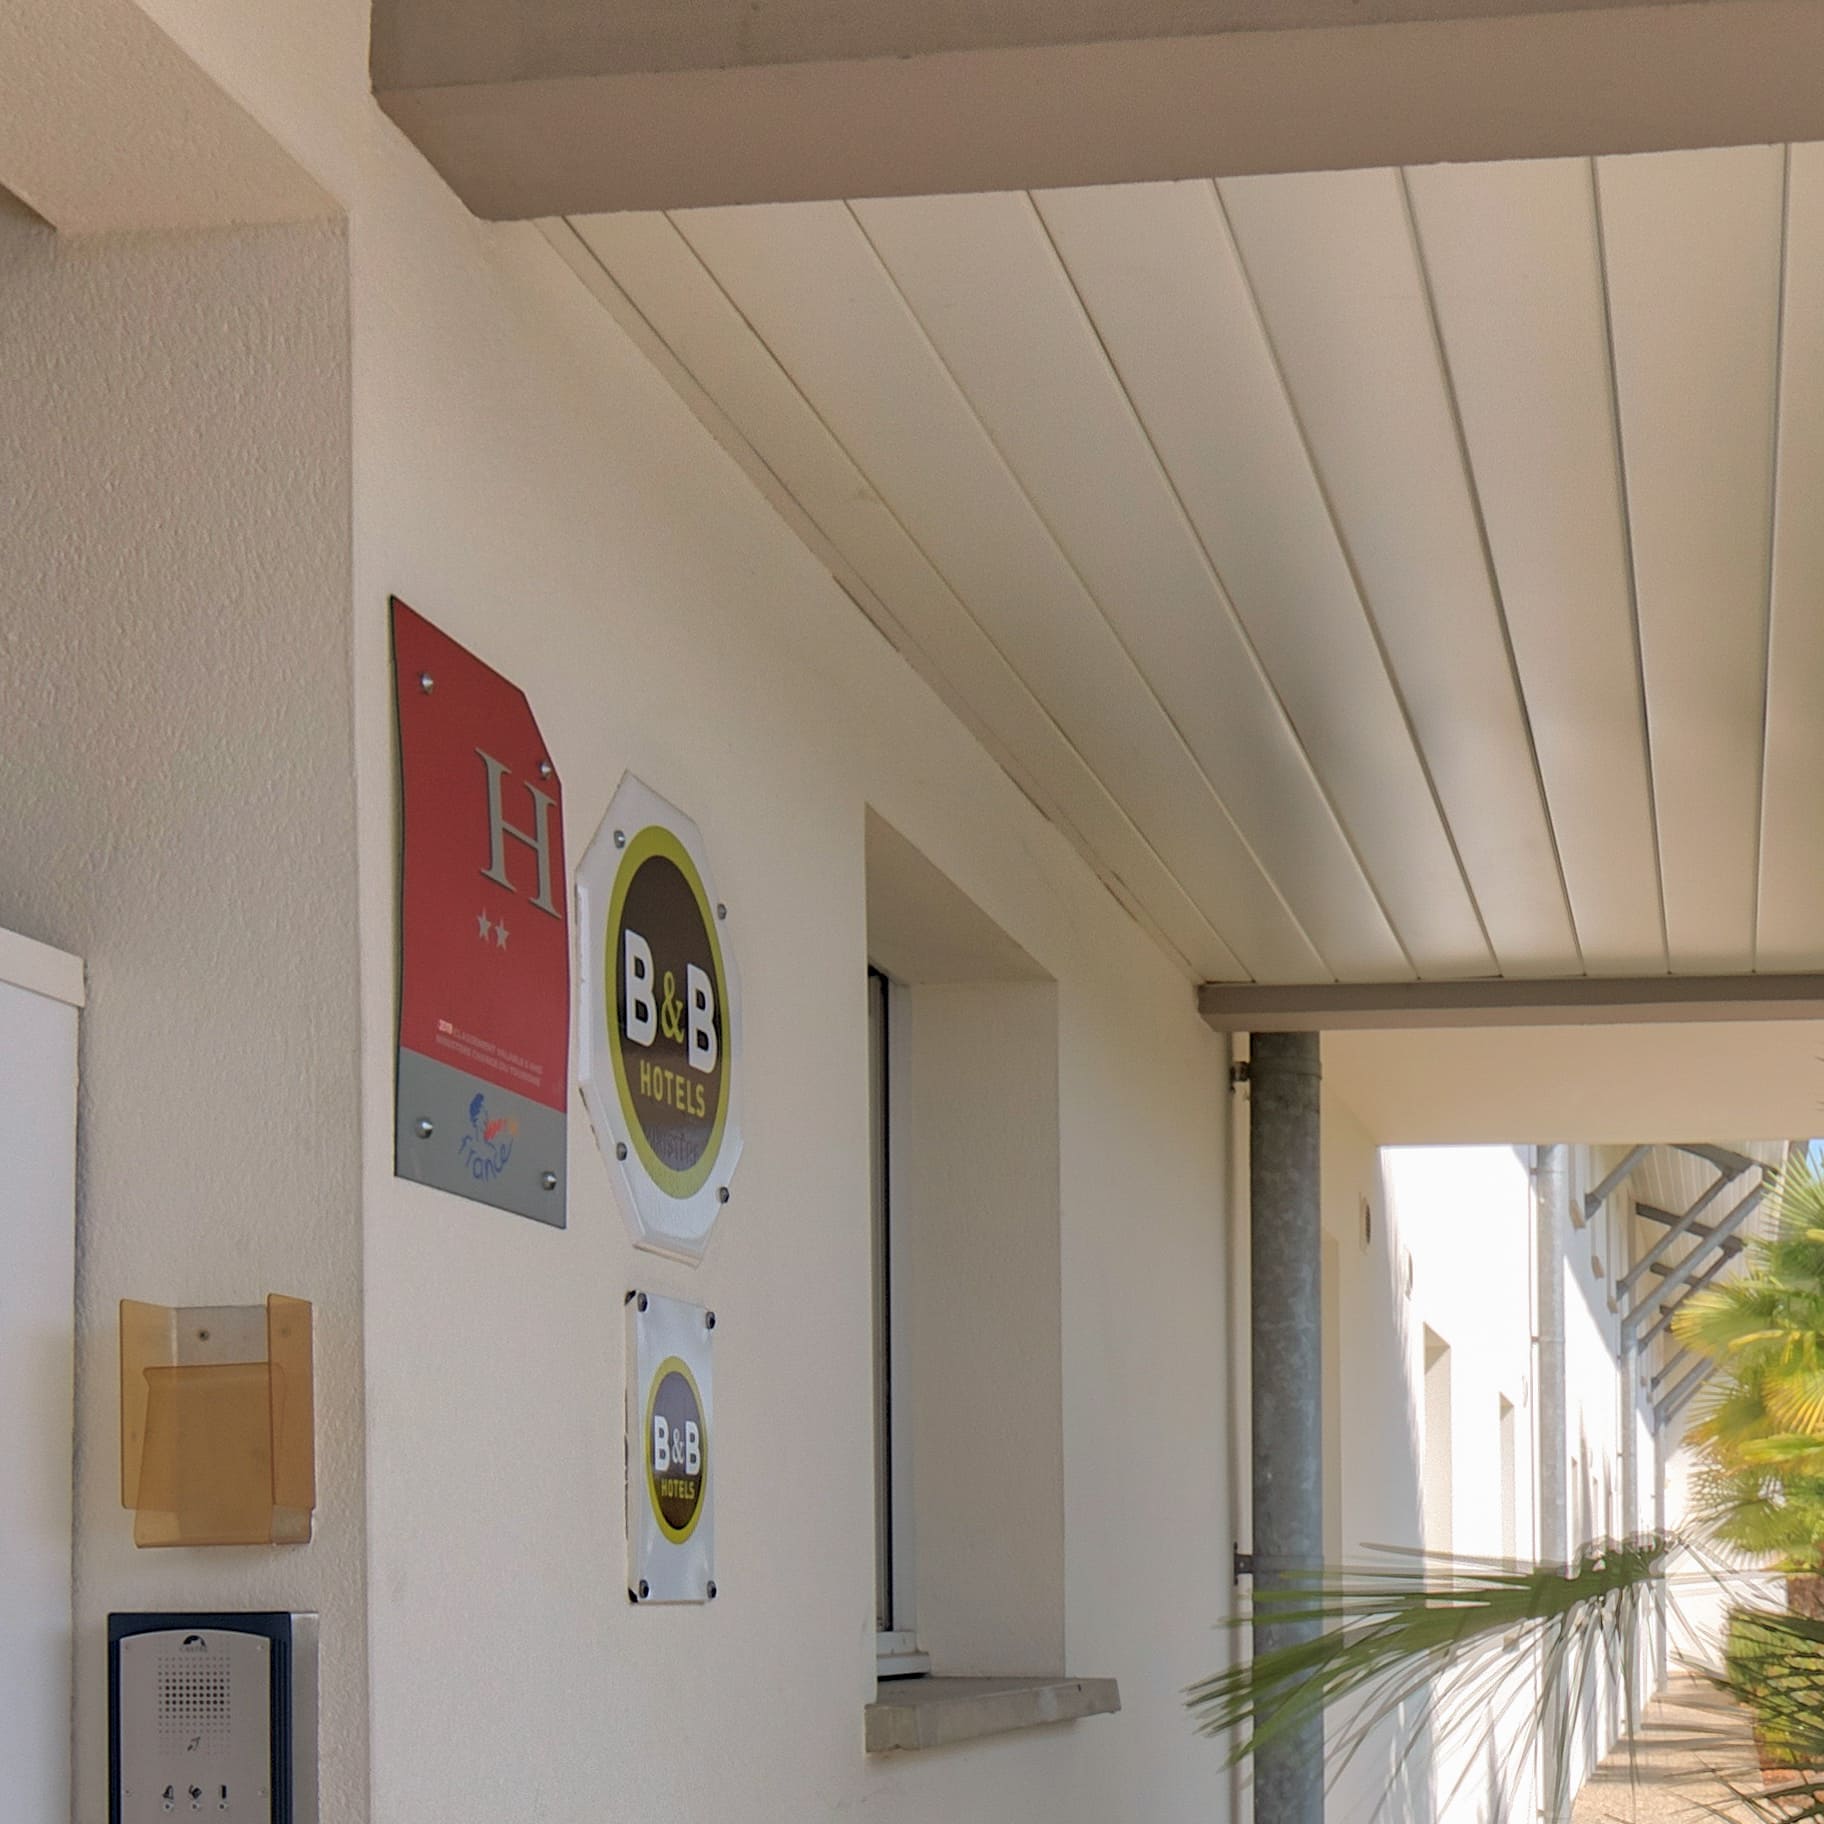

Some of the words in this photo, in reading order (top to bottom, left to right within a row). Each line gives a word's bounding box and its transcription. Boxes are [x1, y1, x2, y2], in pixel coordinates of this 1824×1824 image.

[475, 747, 562, 919] H
[623, 928, 719, 1075] B&B
[639, 1059, 706, 1120] HOTELS
[653, 1415, 701, 1476] B&B
[660, 1478, 696, 1500] HOTELS
